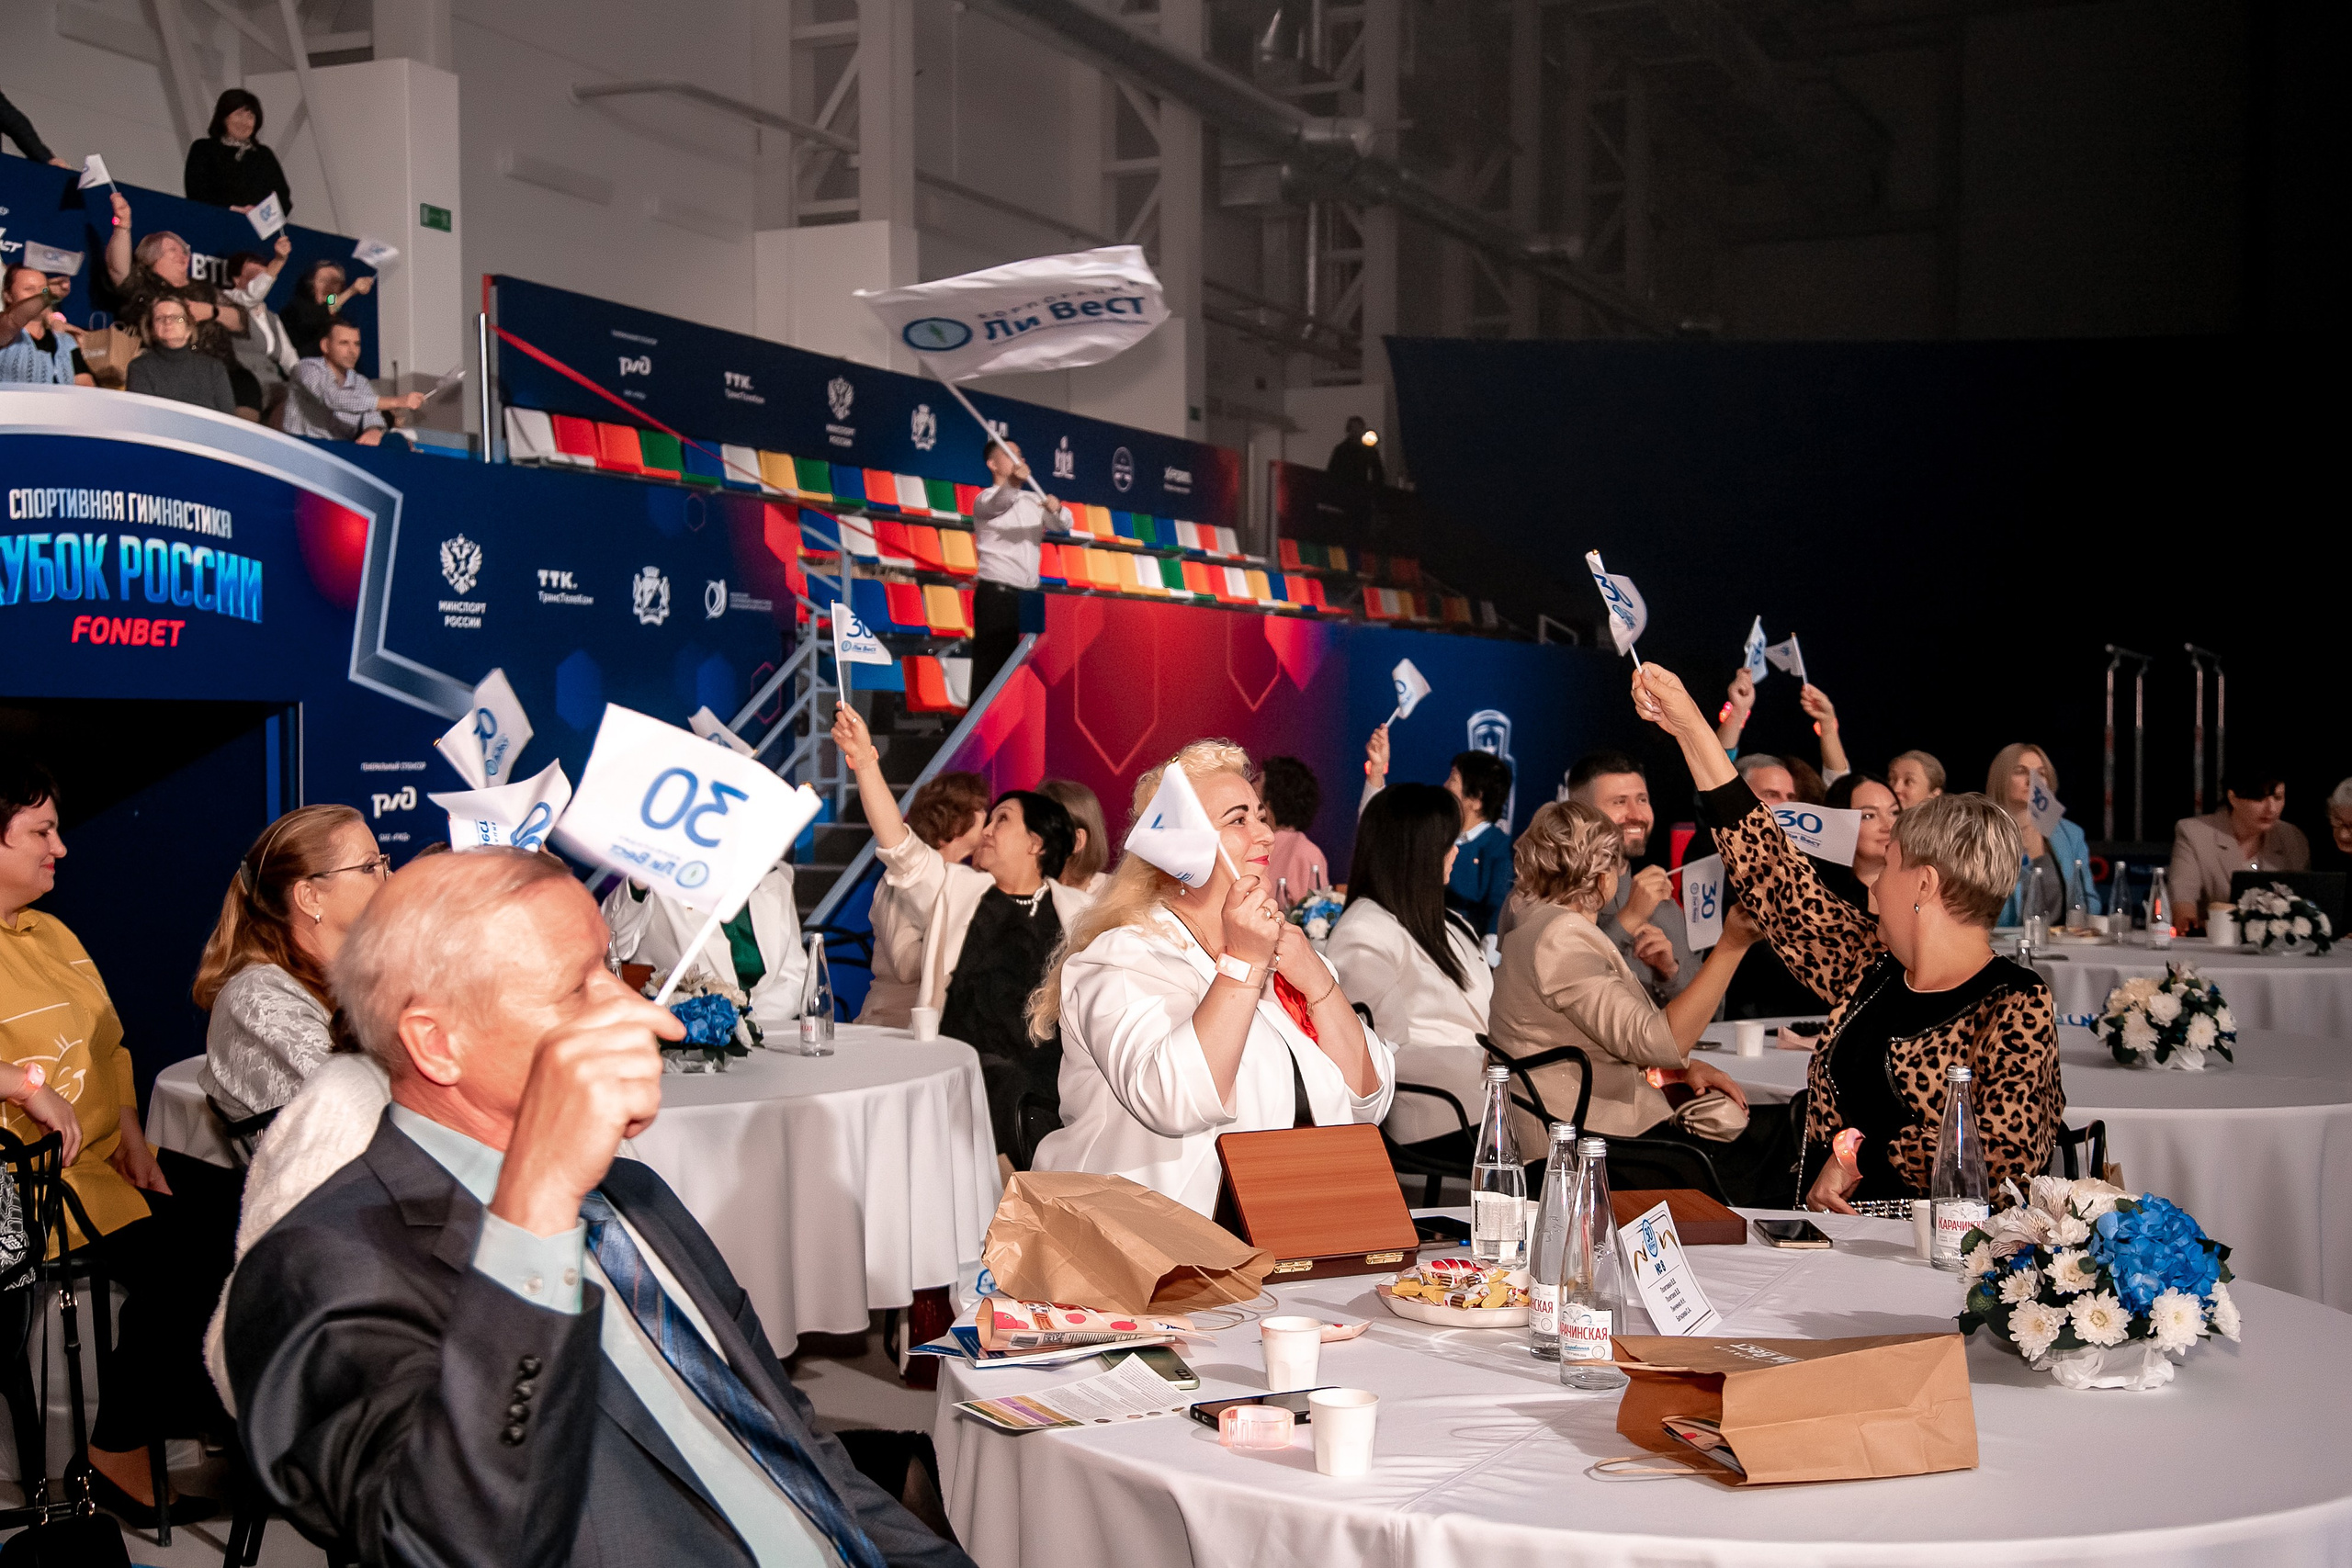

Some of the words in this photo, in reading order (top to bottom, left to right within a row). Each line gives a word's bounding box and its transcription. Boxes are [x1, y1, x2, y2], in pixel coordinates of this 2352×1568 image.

[984, 315, 1041, 341] Ли
[8, 488, 125, 521] СПОРТИВНАЯ
[128, 491, 233, 539] ГИМНАСТИКА
[119, 534, 264, 624] РОССИИ
[71, 615, 187, 648] FONBET
[1774, 809, 1823, 834] 30
[1702, 881, 1716, 919] 30
